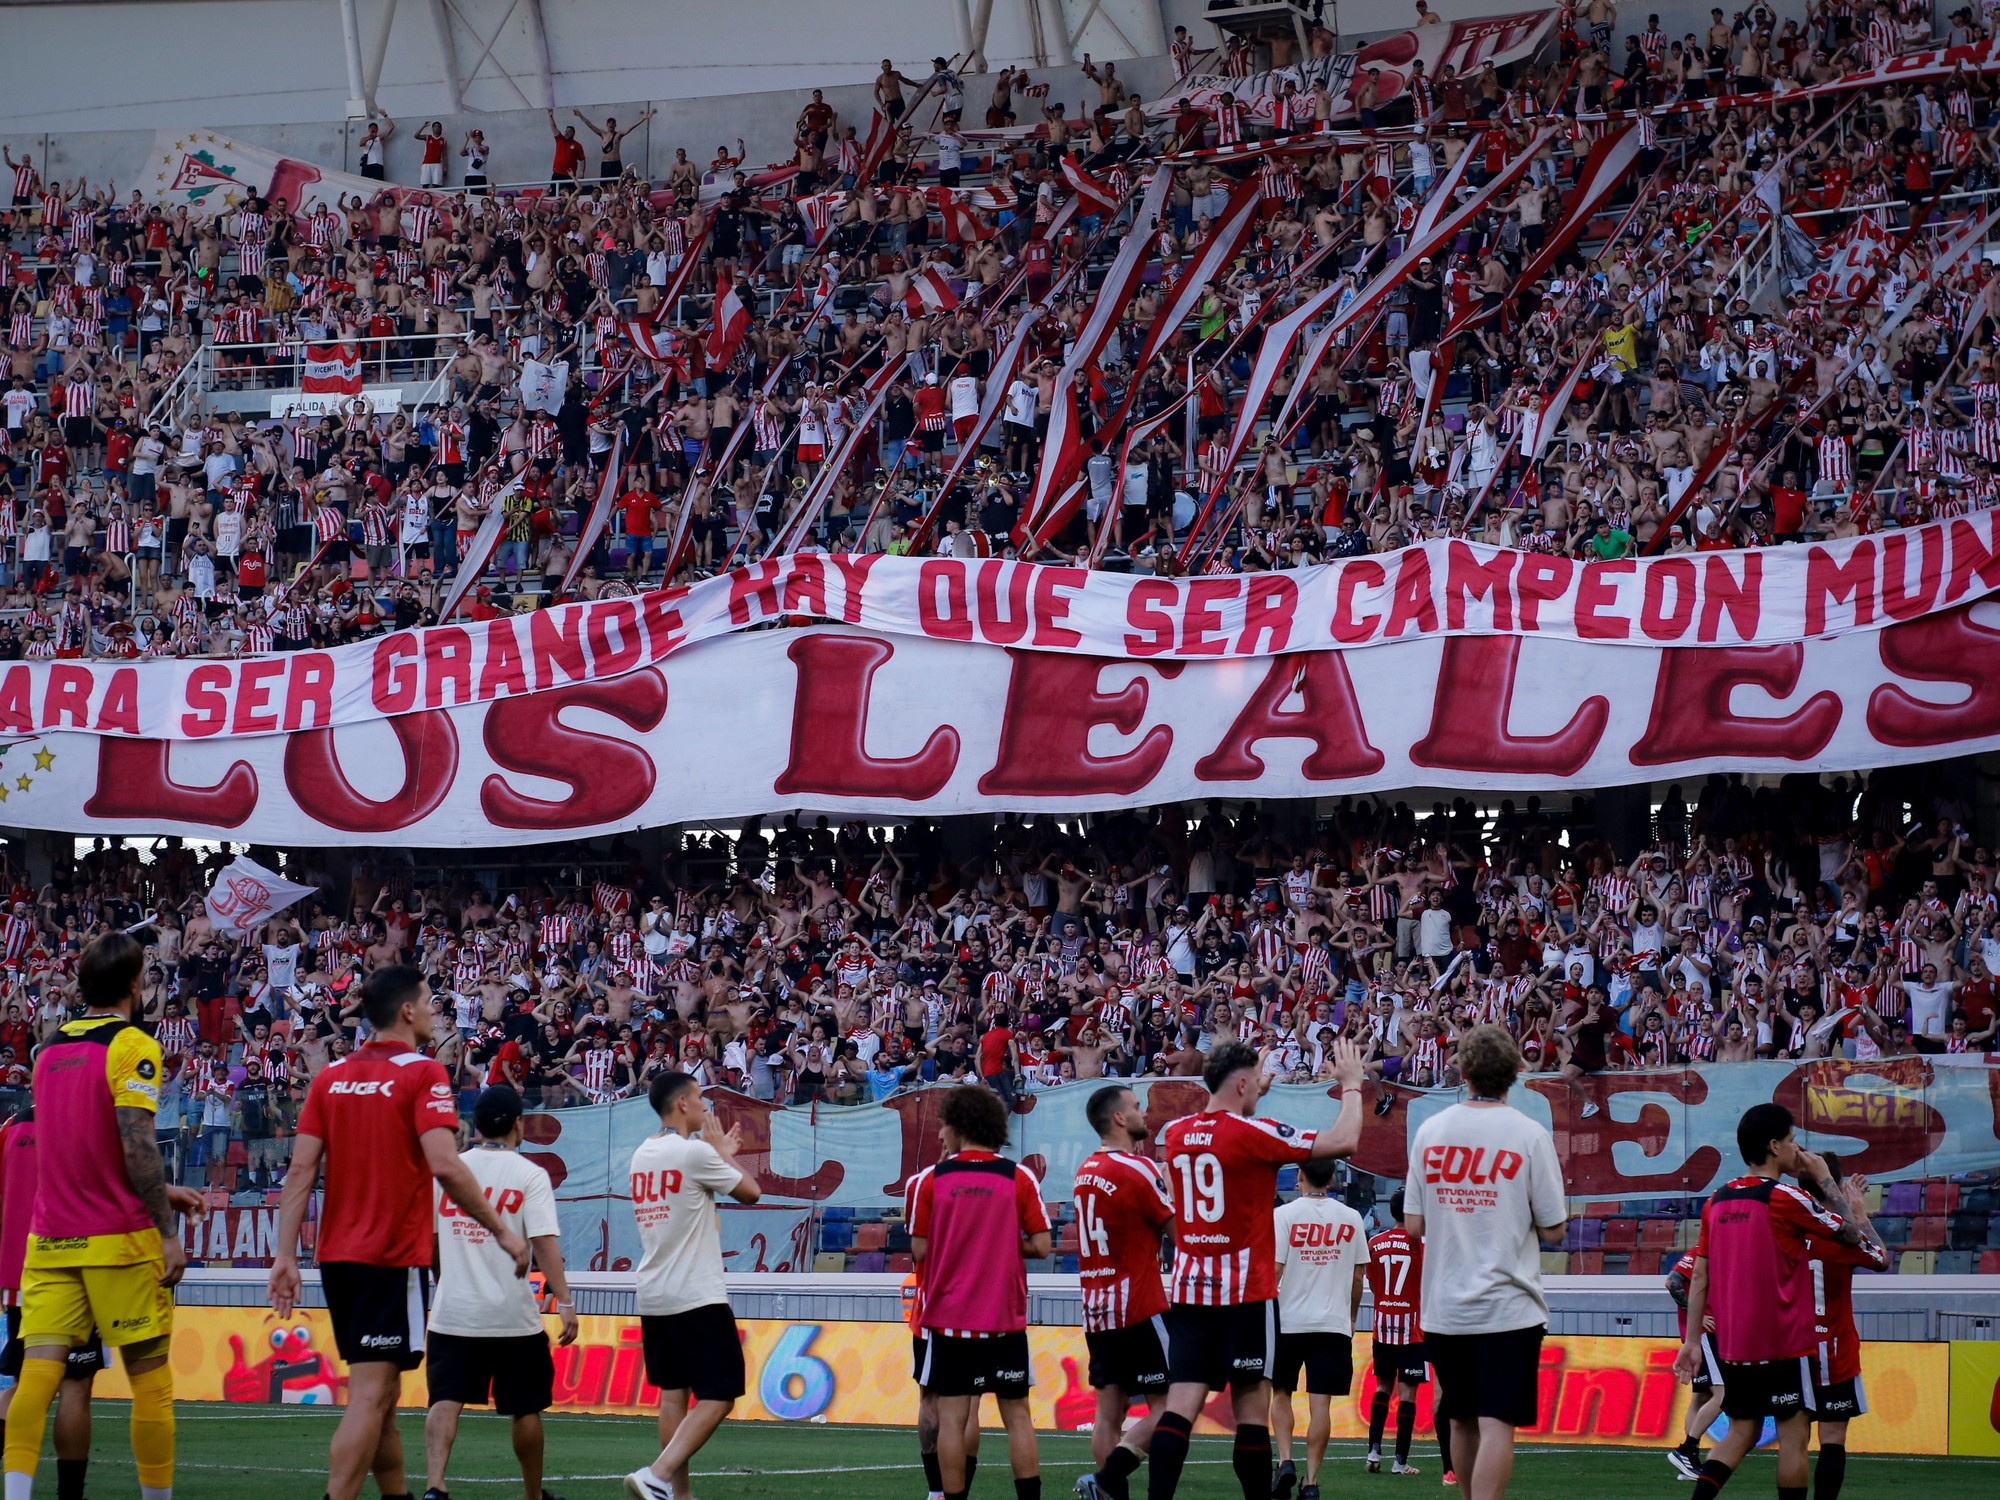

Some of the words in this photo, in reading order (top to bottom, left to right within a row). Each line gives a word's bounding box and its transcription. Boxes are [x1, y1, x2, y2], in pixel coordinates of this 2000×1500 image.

[289, 402, 325, 412] SALIDA
[181, 652, 334, 737] SER
[372, 585, 692, 713] GRANDE
[728, 553, 885, 625] HAY
[919, 559, 1087, 648] QUE
[1124, 574, 1300, 657] SER
[1330, 540, 1764, 643] CAMPEON
[83, 666, 668, 832] LOS
[774, 595, 2000, 801] LEALES
[328, 1081, 381, 1096] AUGE
[1183, 1133, 1213, 1147] GAICH
[1423, 1145, 1524, 1185] EDLP
[630, 1169, 683, 1204] DLP
[1092, 1175, 1118, 1197] PIREZ
[1173, 1152, 1225, 1223] 19
[1450, 1197, 1463, 1205] LA
[1466, 1198, 1496, 1207] PLATA
[1074, 1193, 1109, 1258] 14
[1289, 1223, 1356, 1248] EDLP
[1373, 1240, 1391, 1252] TOBIO
[1379, 1254, 1411, 1296] 17
[122, 1315, 152, 1328] placo
[371, 1334, 403, 1348] placo
[760, 1324, 835, 1420] 6
[1241, 1357, 1263, 1369] placo
